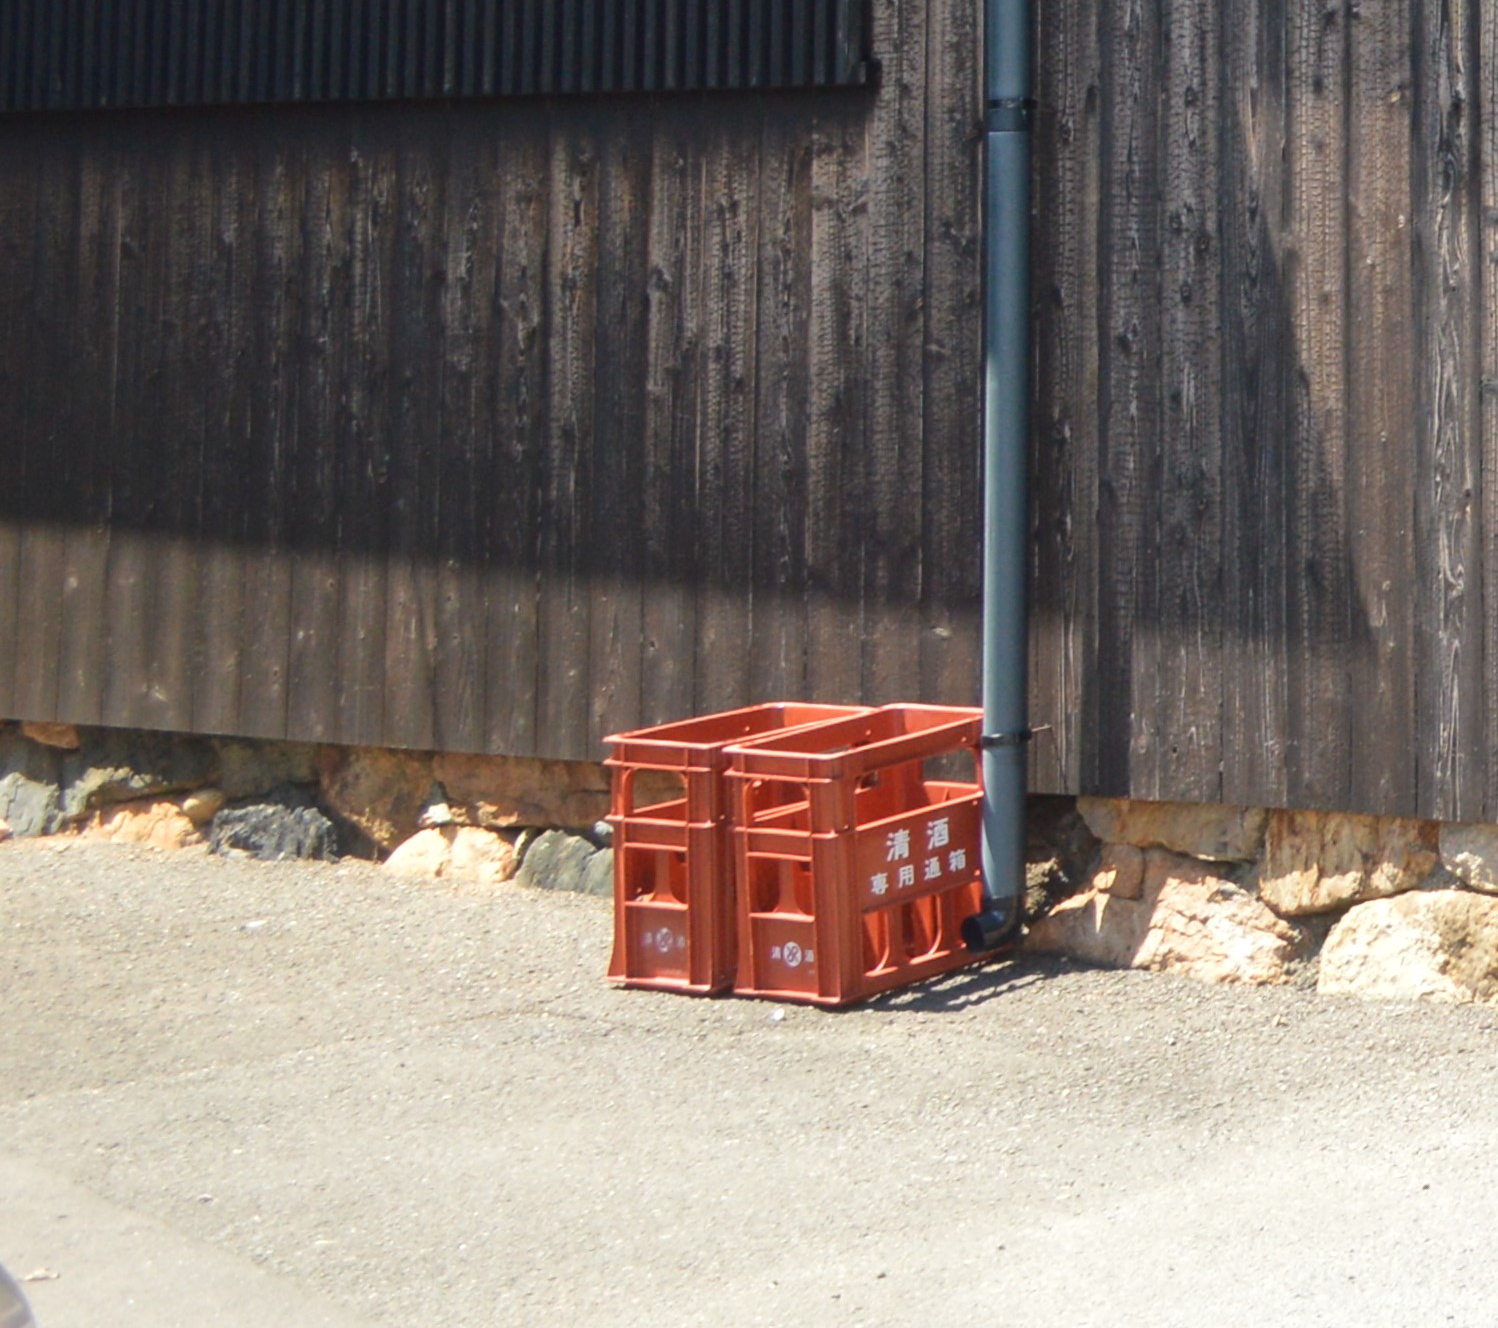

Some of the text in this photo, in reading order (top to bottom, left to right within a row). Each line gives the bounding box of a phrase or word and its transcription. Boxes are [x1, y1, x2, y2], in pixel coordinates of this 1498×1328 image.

[886, 817, 949, 862] 清酒
[870, 848, 966, 895] 専用通箱
